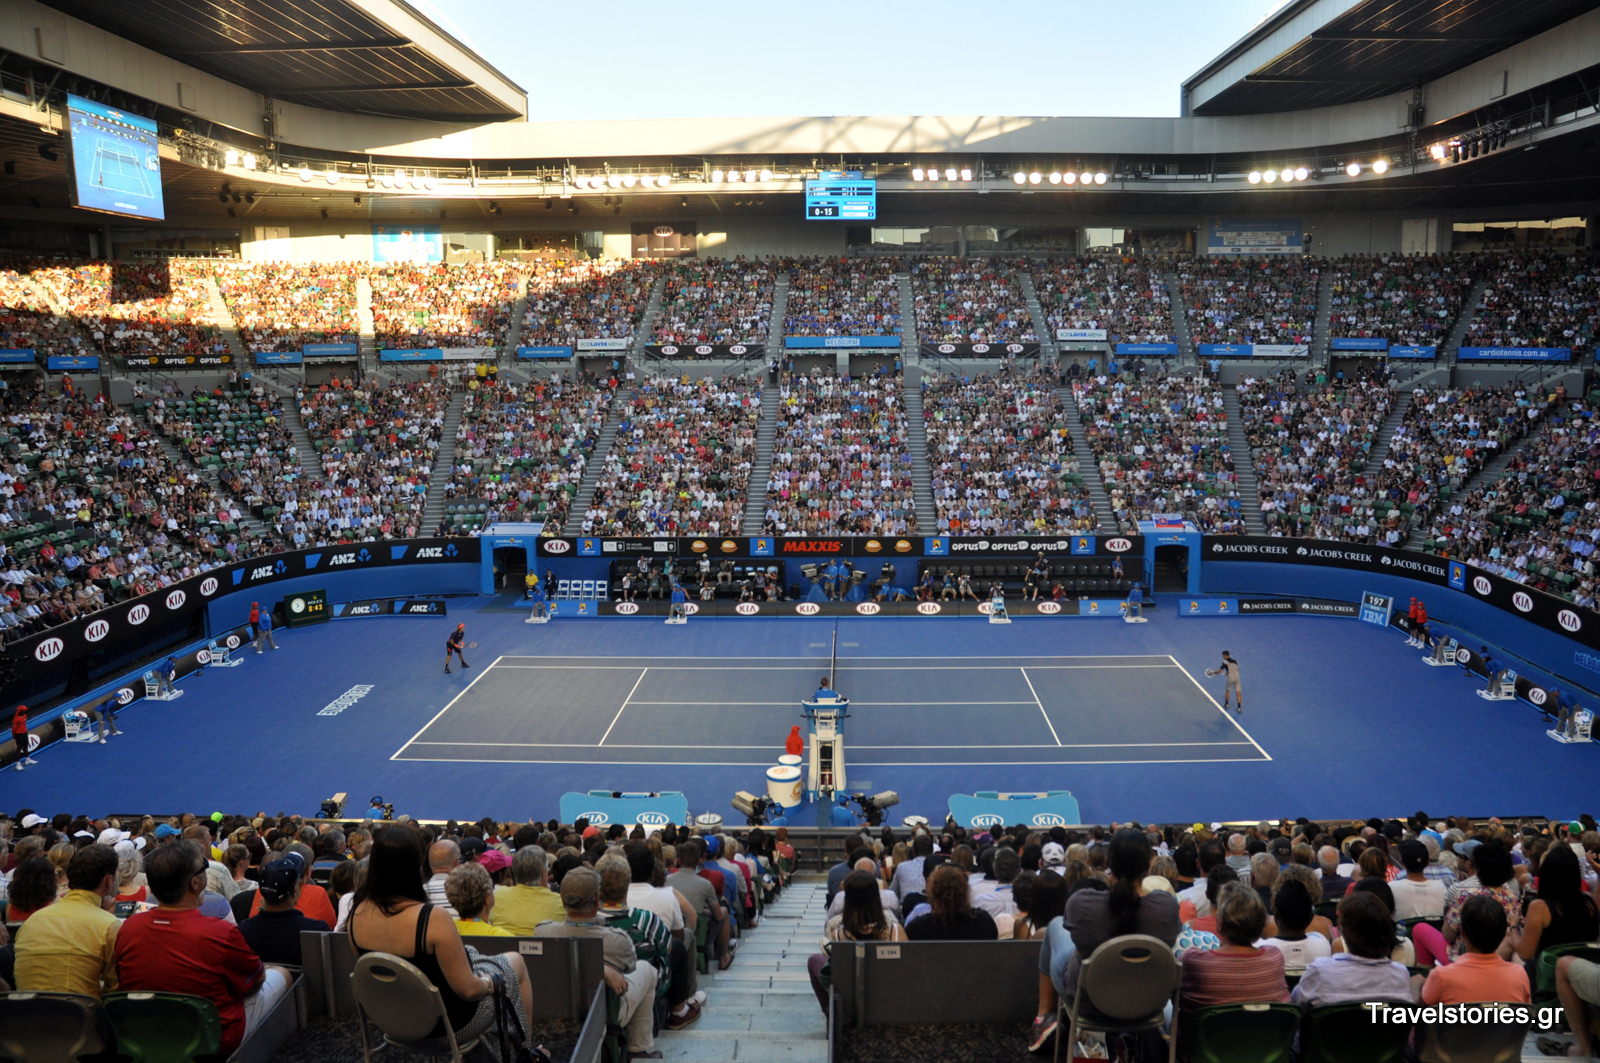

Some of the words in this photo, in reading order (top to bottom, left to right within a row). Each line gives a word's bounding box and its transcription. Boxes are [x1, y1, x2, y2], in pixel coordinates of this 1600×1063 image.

[664, 346, 676, 354] KIA
[697, 346, 710, 354] KIA
[732, 346, 745, 354] KIA
[940, 344, 953, 352] KIA
[975, 344, 988, 352] KIA
[1009, 344, 1022, 352] KIA
[1479, 349, 1549, 358] cardiotennis.com.au
[783, 541, 841, 552] MAXXIS
[952, 543, 979, 551] OPTUS
[991, 543, 1018, 551] OPTUS
[1031, 542, 1058, 550] OPTUS
[1224, 545, 1258, 553] JACOB'S
[1260, 546, 1289, 555] CREEK
[416, 547, 443, 558] ANZ
[1308, 548, 1342, 559] JACOB'S
[1344, 552, 1372, 563] CREEK
[329, 552, 356, 566] ANZ
[251, 565, 273, 580] ANZ
[1392, 558, 1422, 572] JACOB'S
[1422, 565, 1446, 577] CREEK
[202, 580, 216, 594] KIA
[1476, 578, 1489, 592] KIA
[168, 592, 184, 607] KIA
[1370, 596, 1384, 606] 197
[1515, 594, 1530, 610] KIA
[351, 606, 370, 614] ANZ
[410, 604, 428, 612] ANZ
[130, 606, 147, 622] KIA
[1363, 610, 1384, 625] IBM
[1561, 612, 1578, 630] KIA
[87, 621, 108, 639] KIA
[228, 637, 239, 648] KIA
[38, 640, 61, 659] KIA
[1458, 650, 1469, 662] KIA
[1530, 690, 1544, 703] KIA
[642, 814, 663, 822] KIA
[977, 817, 998, 826] KIA
[1038, 816, 1059, 826] KIA
